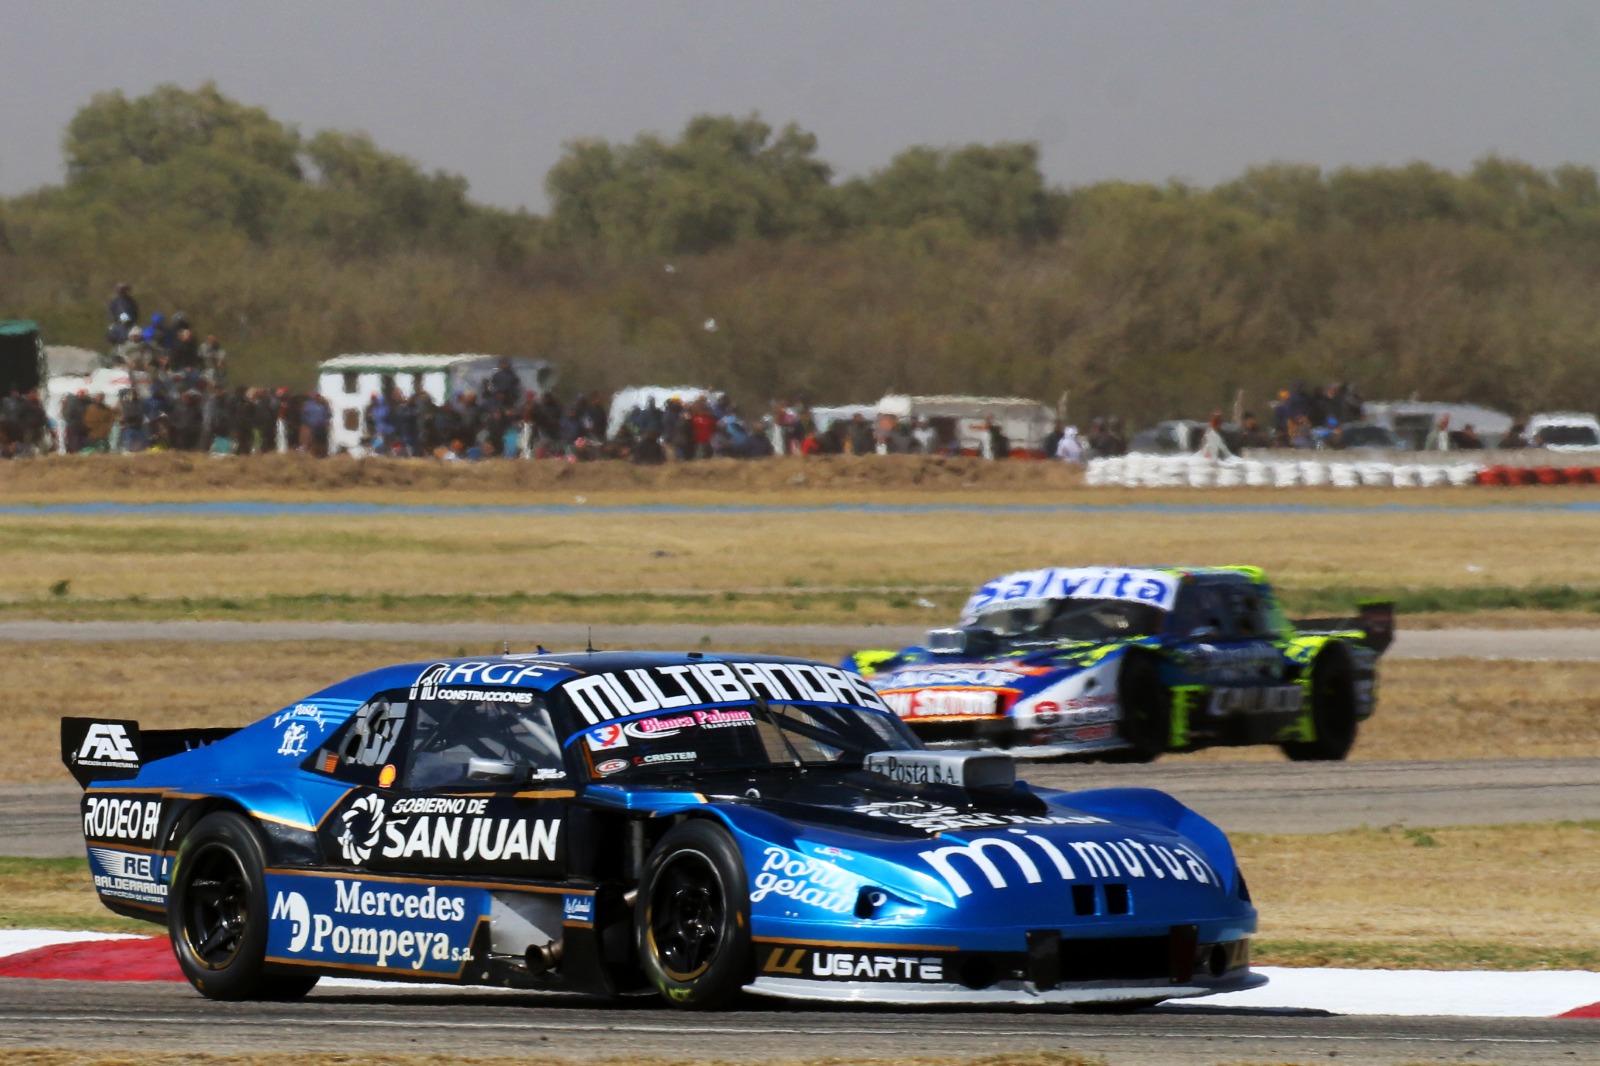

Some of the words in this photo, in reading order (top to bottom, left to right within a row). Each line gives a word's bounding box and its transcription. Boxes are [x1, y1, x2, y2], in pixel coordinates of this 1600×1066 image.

[446, 662, 560, 685] RGF
[438, 690, 533, 704] CONSTRUCCIONES
[562, 663, 891, 725] MULTIBANDAS
[639, 717, 696, 733] Blanca
[693, 709, 754, 725] Paloma
[701, 720, 756, 729] TRANSPORTES
[78, 723, 139, 761] FAE
[643, 751, 697, 762] CRISTEM
[887, 756, 928, 784] Posta
[84, 797, 142, 839] RODEO
[392, 798, 465, 814] GOBIERNO
[466, 799, 489, 814] DE
[382, 816, 464, 859] SAN
[463, 817, 562, 861] JUAN
[918, 828, 1076, 899] mi
[1068, 838, 1221, 888] mutual
[334, 879, 465, 922] Mercedes
[311, 914, 450, 970] Pompeya
[812, 952, 943, 980] UGARTE
